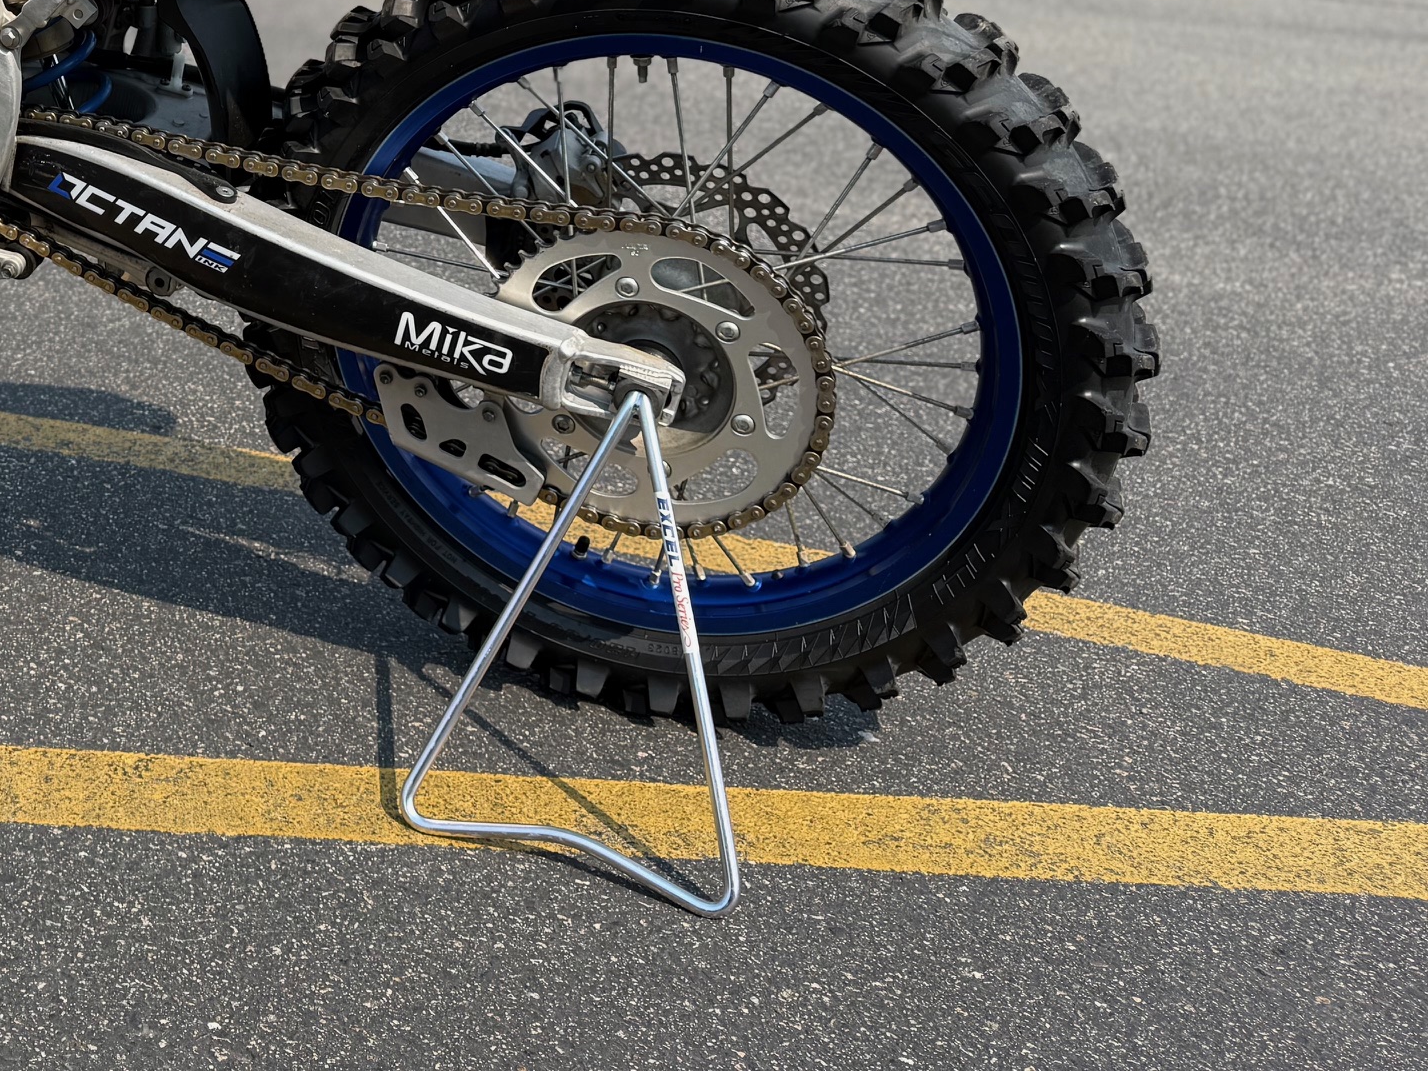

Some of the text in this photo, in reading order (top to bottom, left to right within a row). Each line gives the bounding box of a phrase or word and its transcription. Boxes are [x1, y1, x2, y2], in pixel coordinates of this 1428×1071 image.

[47, 171, 242, 269] OCTANE
[196, 256, 228, 273] INK
[393, 311, 514, 376] Mika
[404, 340, 470, 370] Metals
[657, 497, 692, 648] EXCEL Pro Series
